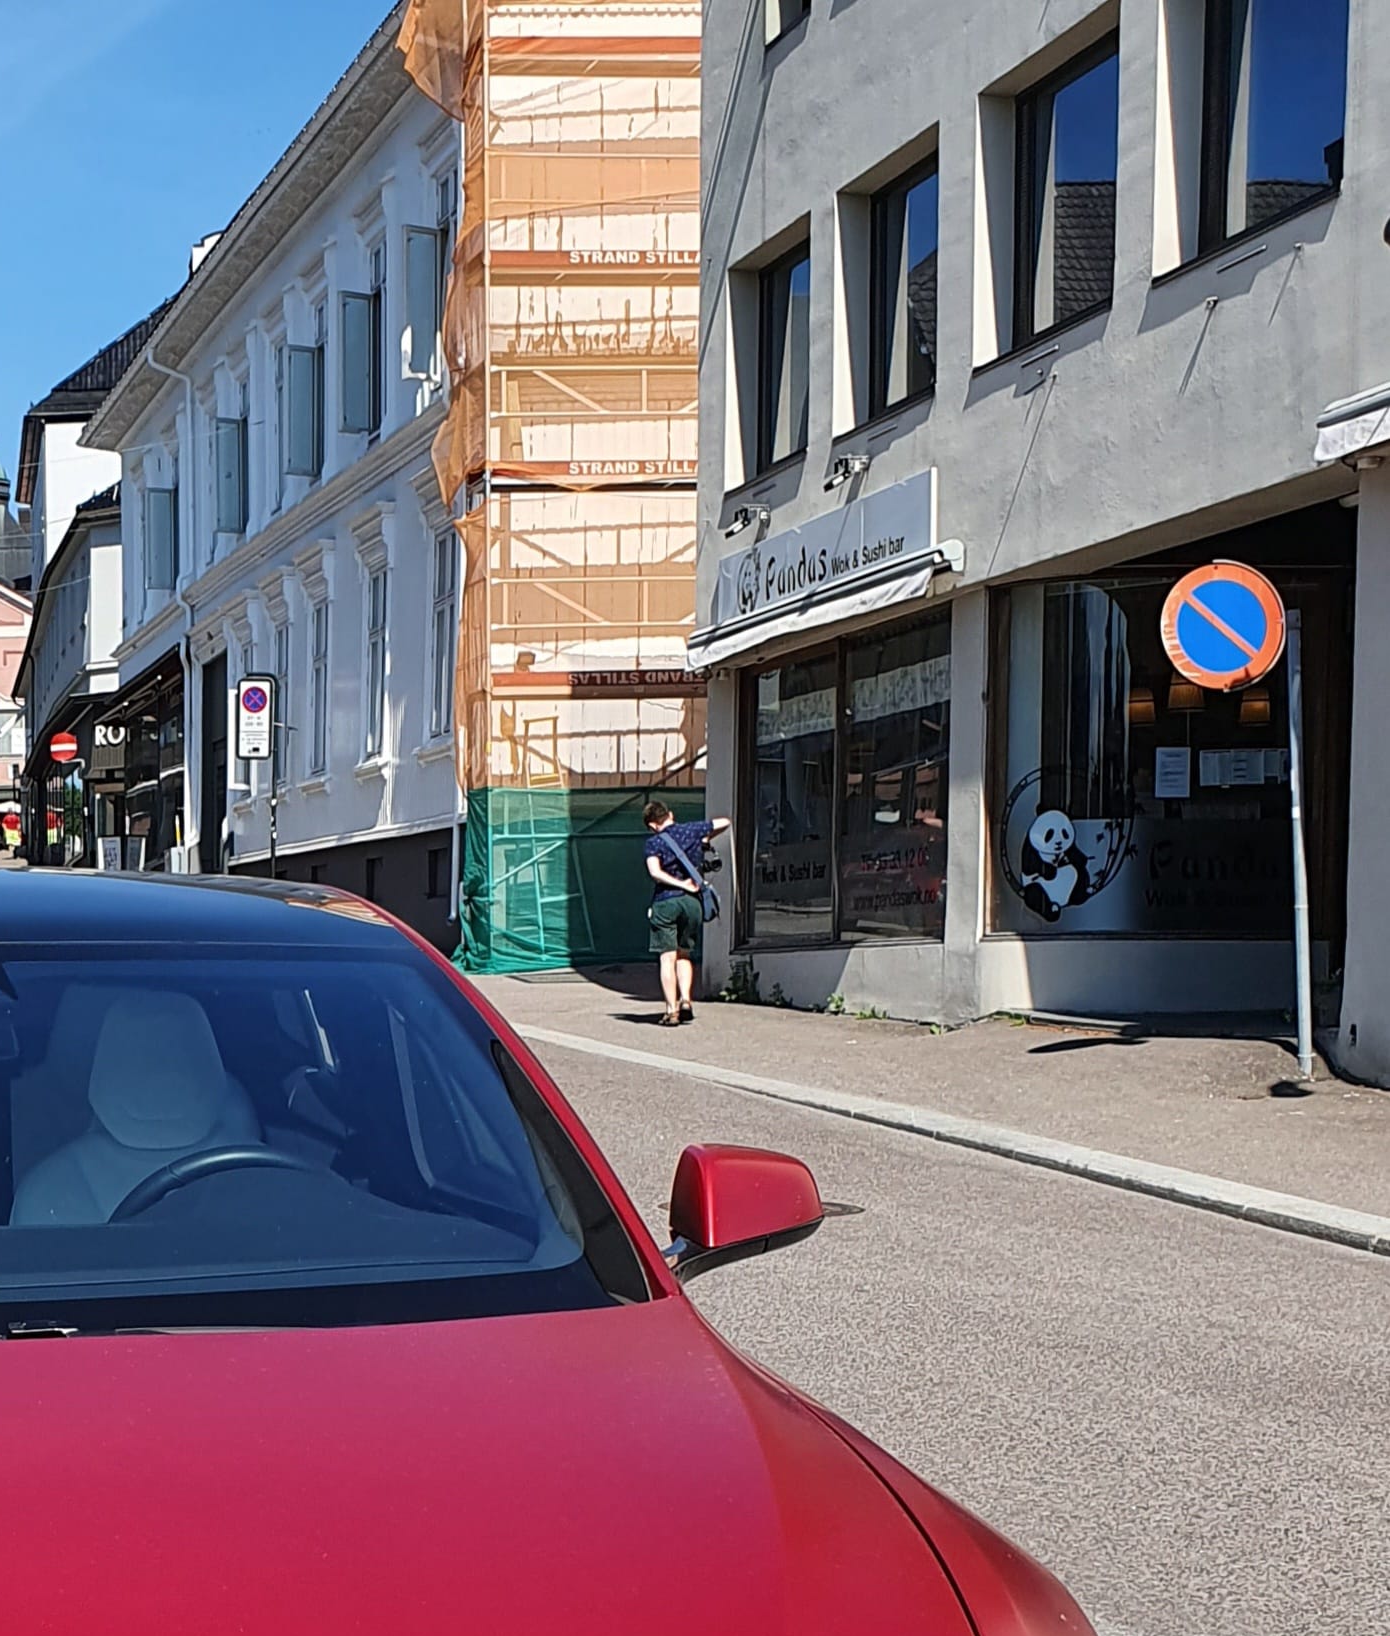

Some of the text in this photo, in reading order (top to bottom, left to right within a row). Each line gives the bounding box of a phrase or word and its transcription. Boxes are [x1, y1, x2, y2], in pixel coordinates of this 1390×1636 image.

[569, 250, 641, 265] STRAND
[569, 460, 640, 475] STRAND
[765, 535, 905, 601] Pandas Wok & Sushi bar
[568, 670, 706, 686] TRAND STILLAS
